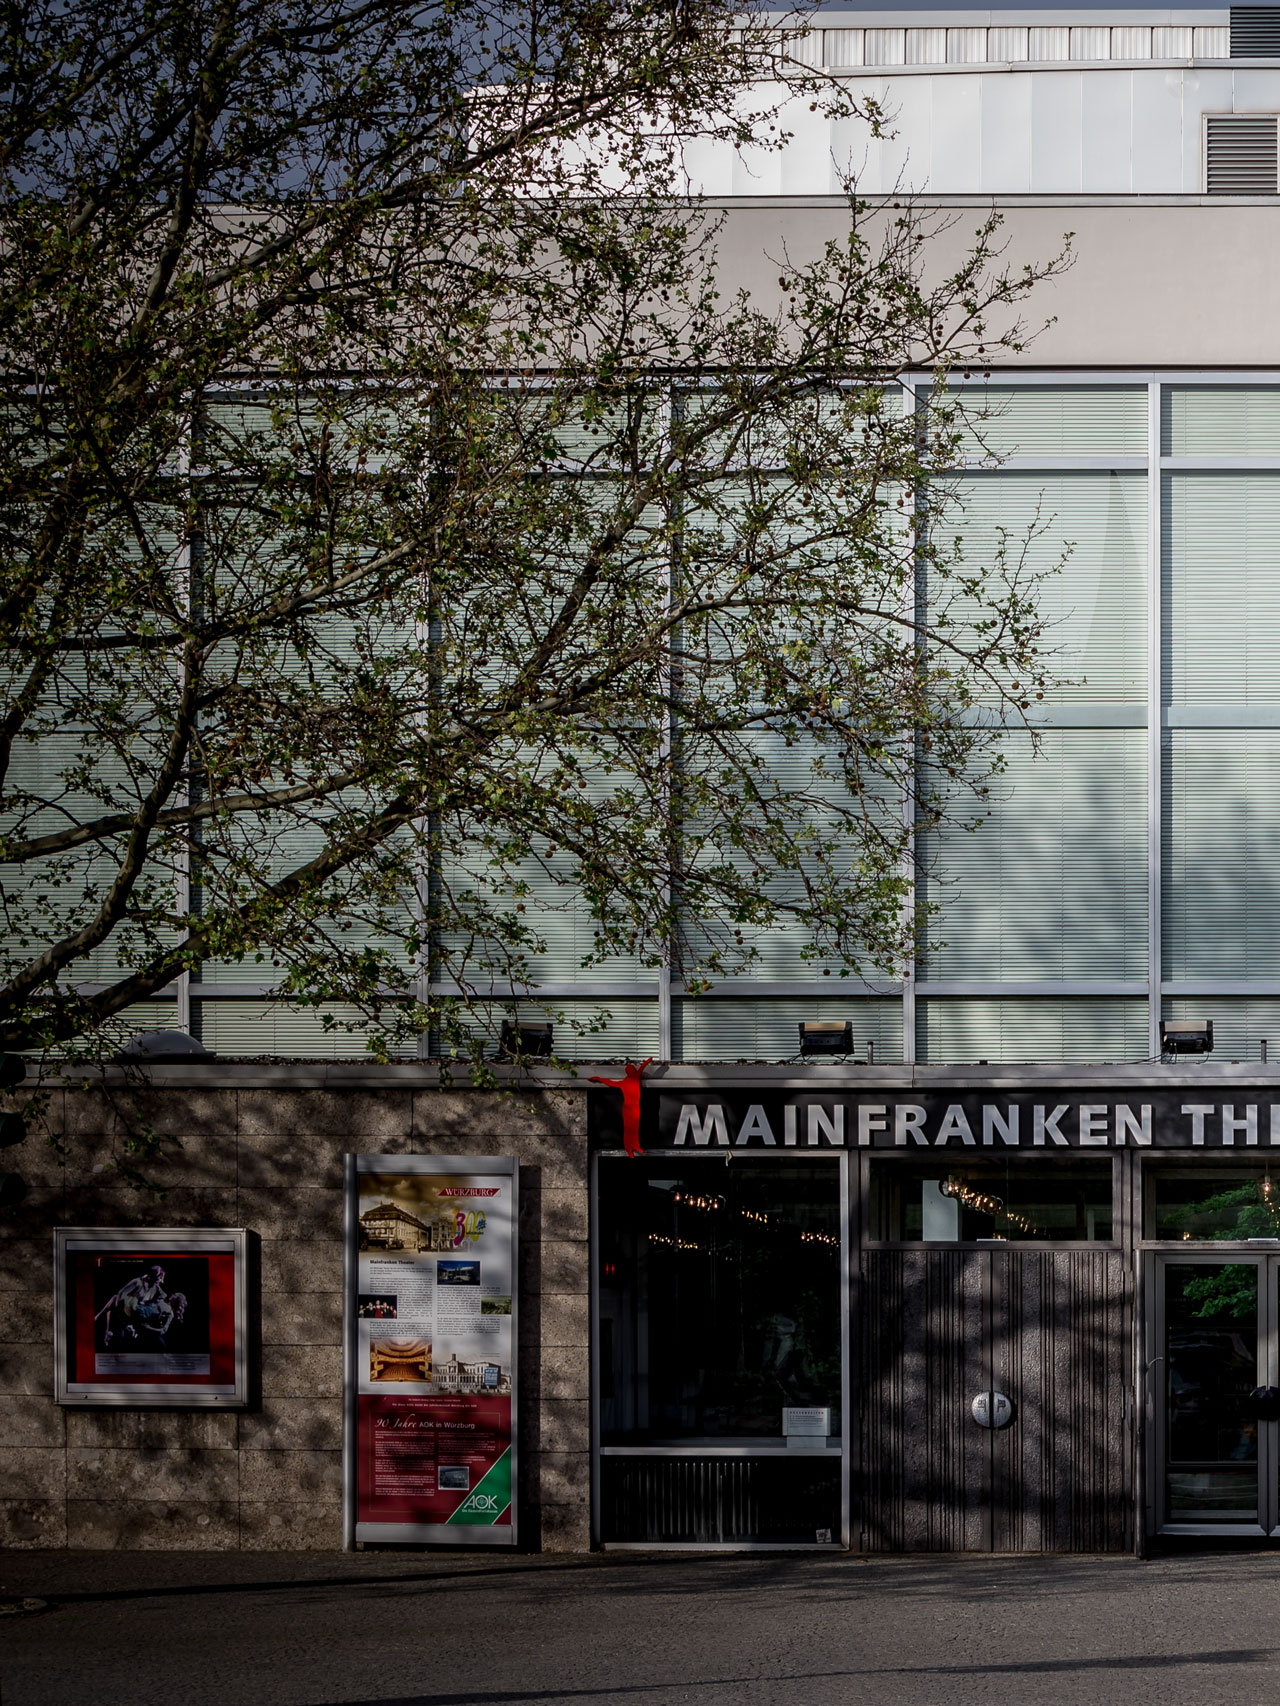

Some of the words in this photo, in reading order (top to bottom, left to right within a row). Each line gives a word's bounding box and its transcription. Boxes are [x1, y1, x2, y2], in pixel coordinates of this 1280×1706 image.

[673, 1103, 1152, 1146] MAINFRANKEN
[374, 1418, 390, 1428] 90
[390, 1413, 417, 1429] Jahre
[443, 1421, 476, 1430] Würzburg
[463, 1494, 498, 1510] AOK
